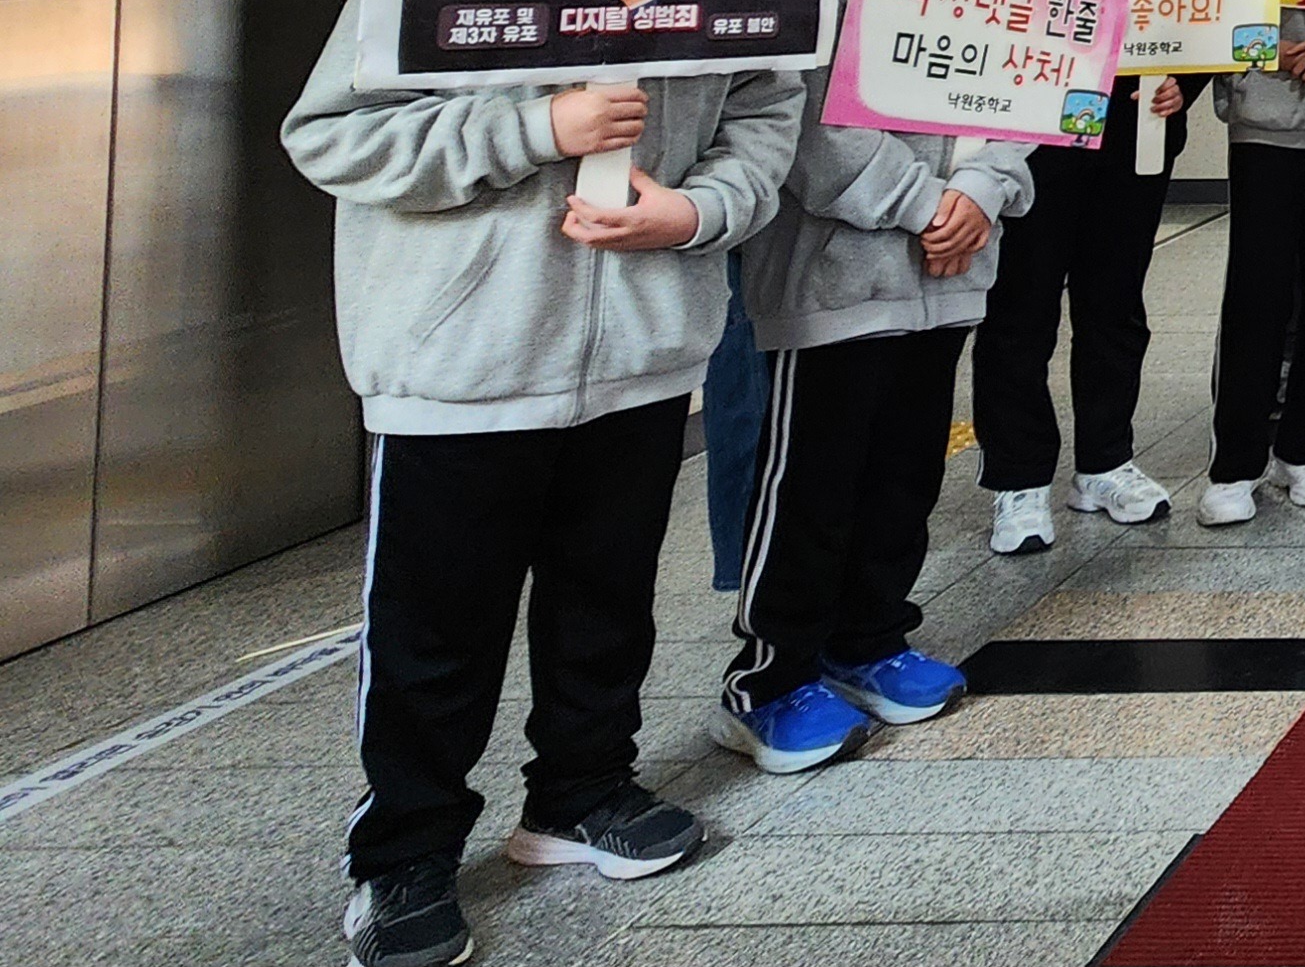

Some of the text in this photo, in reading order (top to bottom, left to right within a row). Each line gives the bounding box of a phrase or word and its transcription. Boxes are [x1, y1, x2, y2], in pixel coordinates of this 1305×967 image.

[455, 7, 535, 26] 재유포 및
[559, 4, 699, 32] 디지털 성범죄
[712, 18, 743, 35] 유포
[448, 24, 538, 44] 제3자 유포
[1123, 41, 1183, 57] 낙원중학교
[892, 32, 1076, 88] 마음의 상처!
[948, 92, 1012, 113] 낙원중학교
